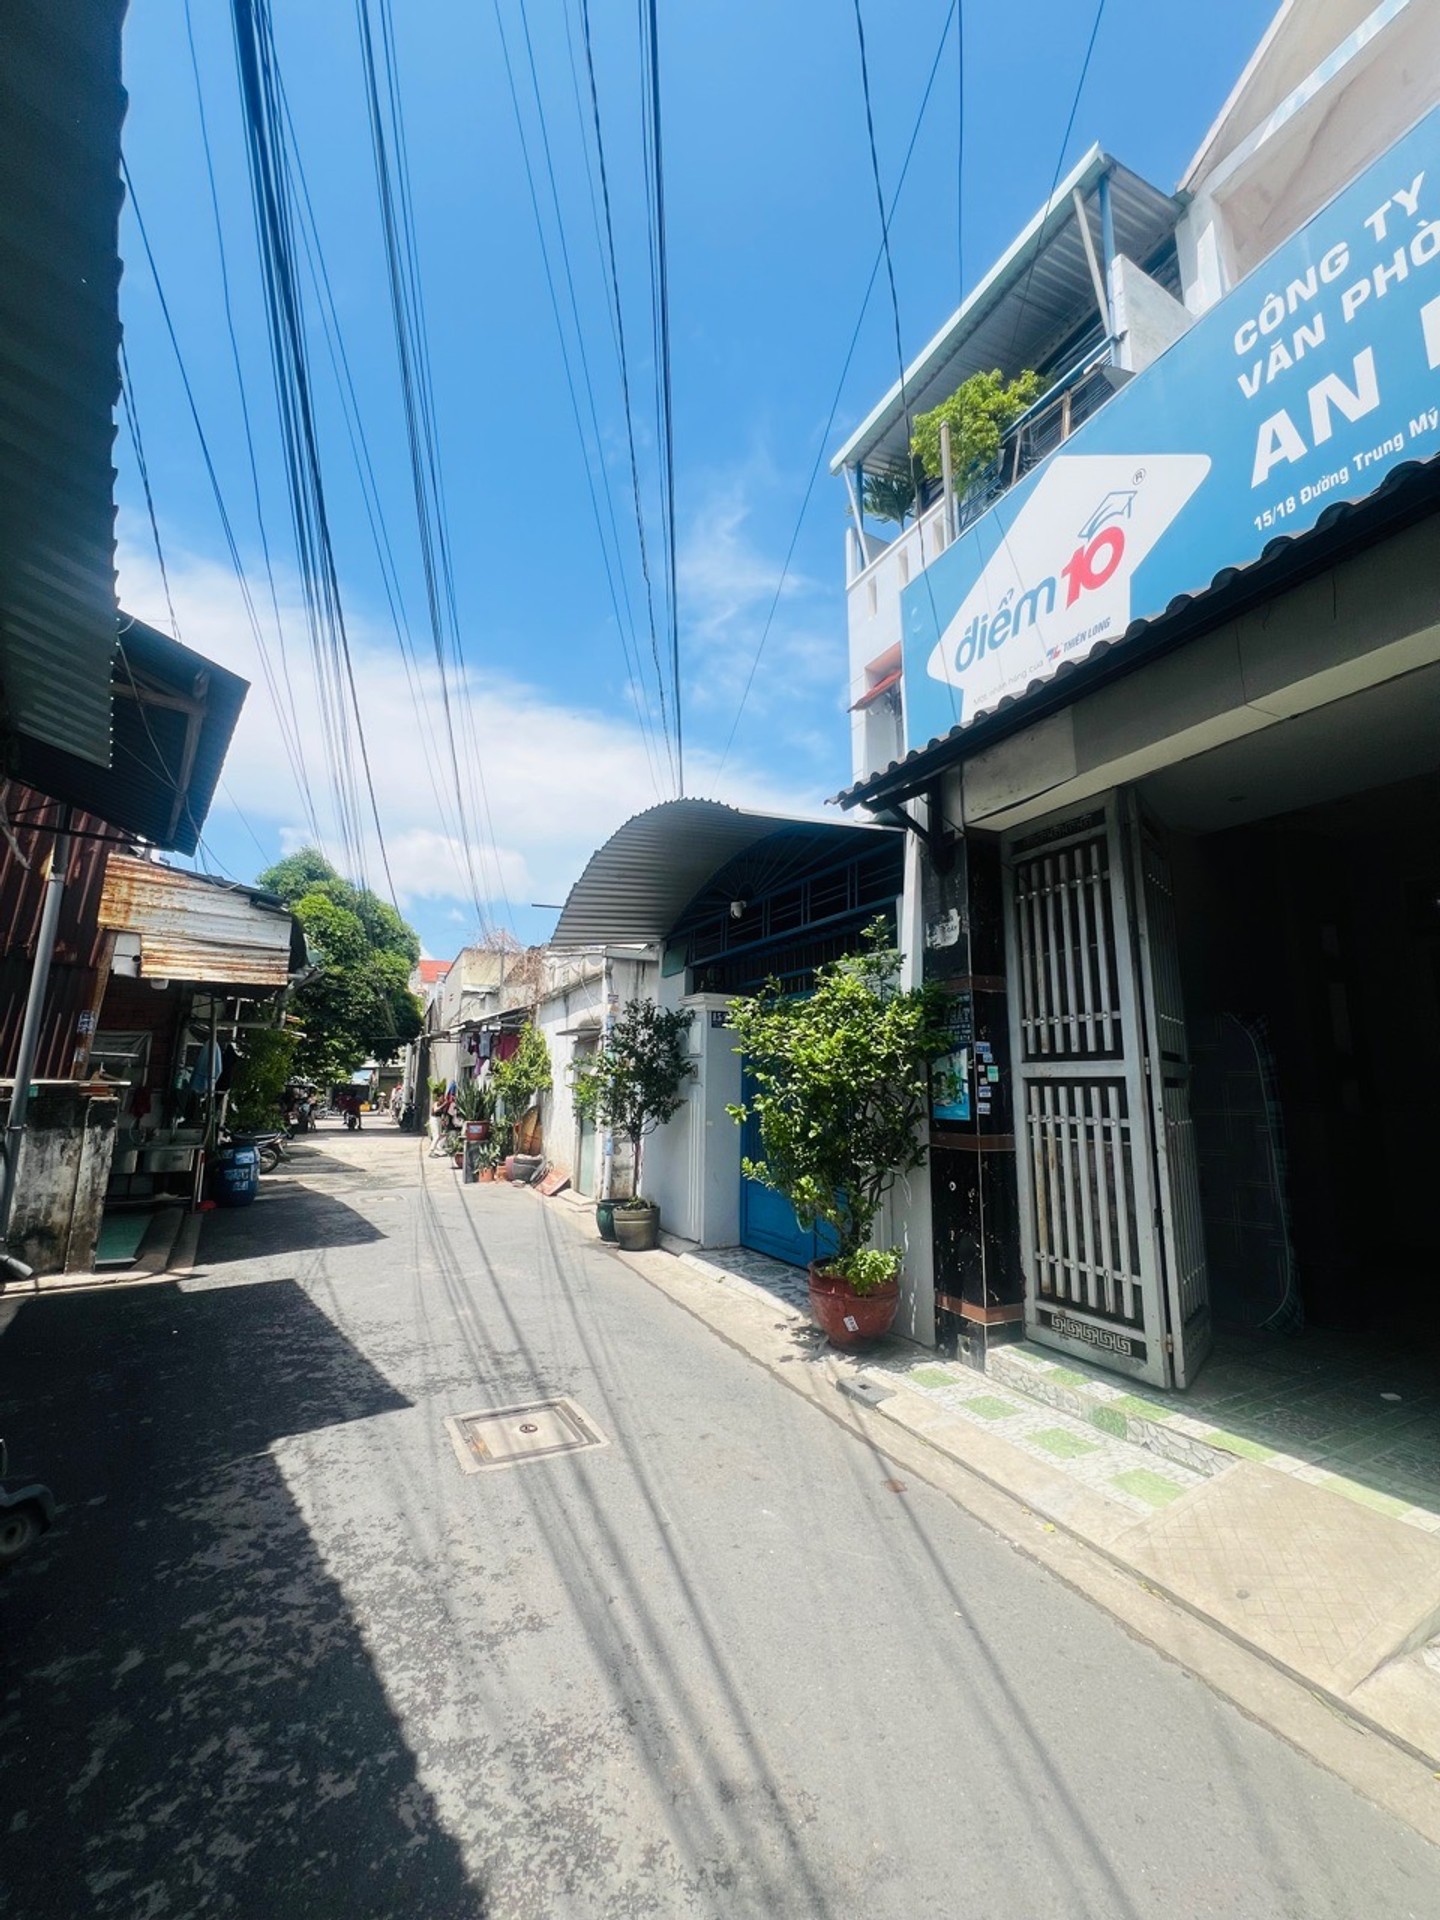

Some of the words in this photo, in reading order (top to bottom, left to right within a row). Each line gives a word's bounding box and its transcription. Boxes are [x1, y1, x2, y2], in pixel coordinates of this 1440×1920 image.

[1234, 241, 1350, 356] CÔNG
[1364, 171, 1425, 243] TY
[1237, 312, 1326, 399] VĂN
[1251, 346, 1380, 489] AN
[1254, 496, 1297, 531] 15/18
[1300, 465, 1349, 505] Đường
[1353, 432, 1404, 472] Trung
[1408, 406, 1440, 438] Mỹ
